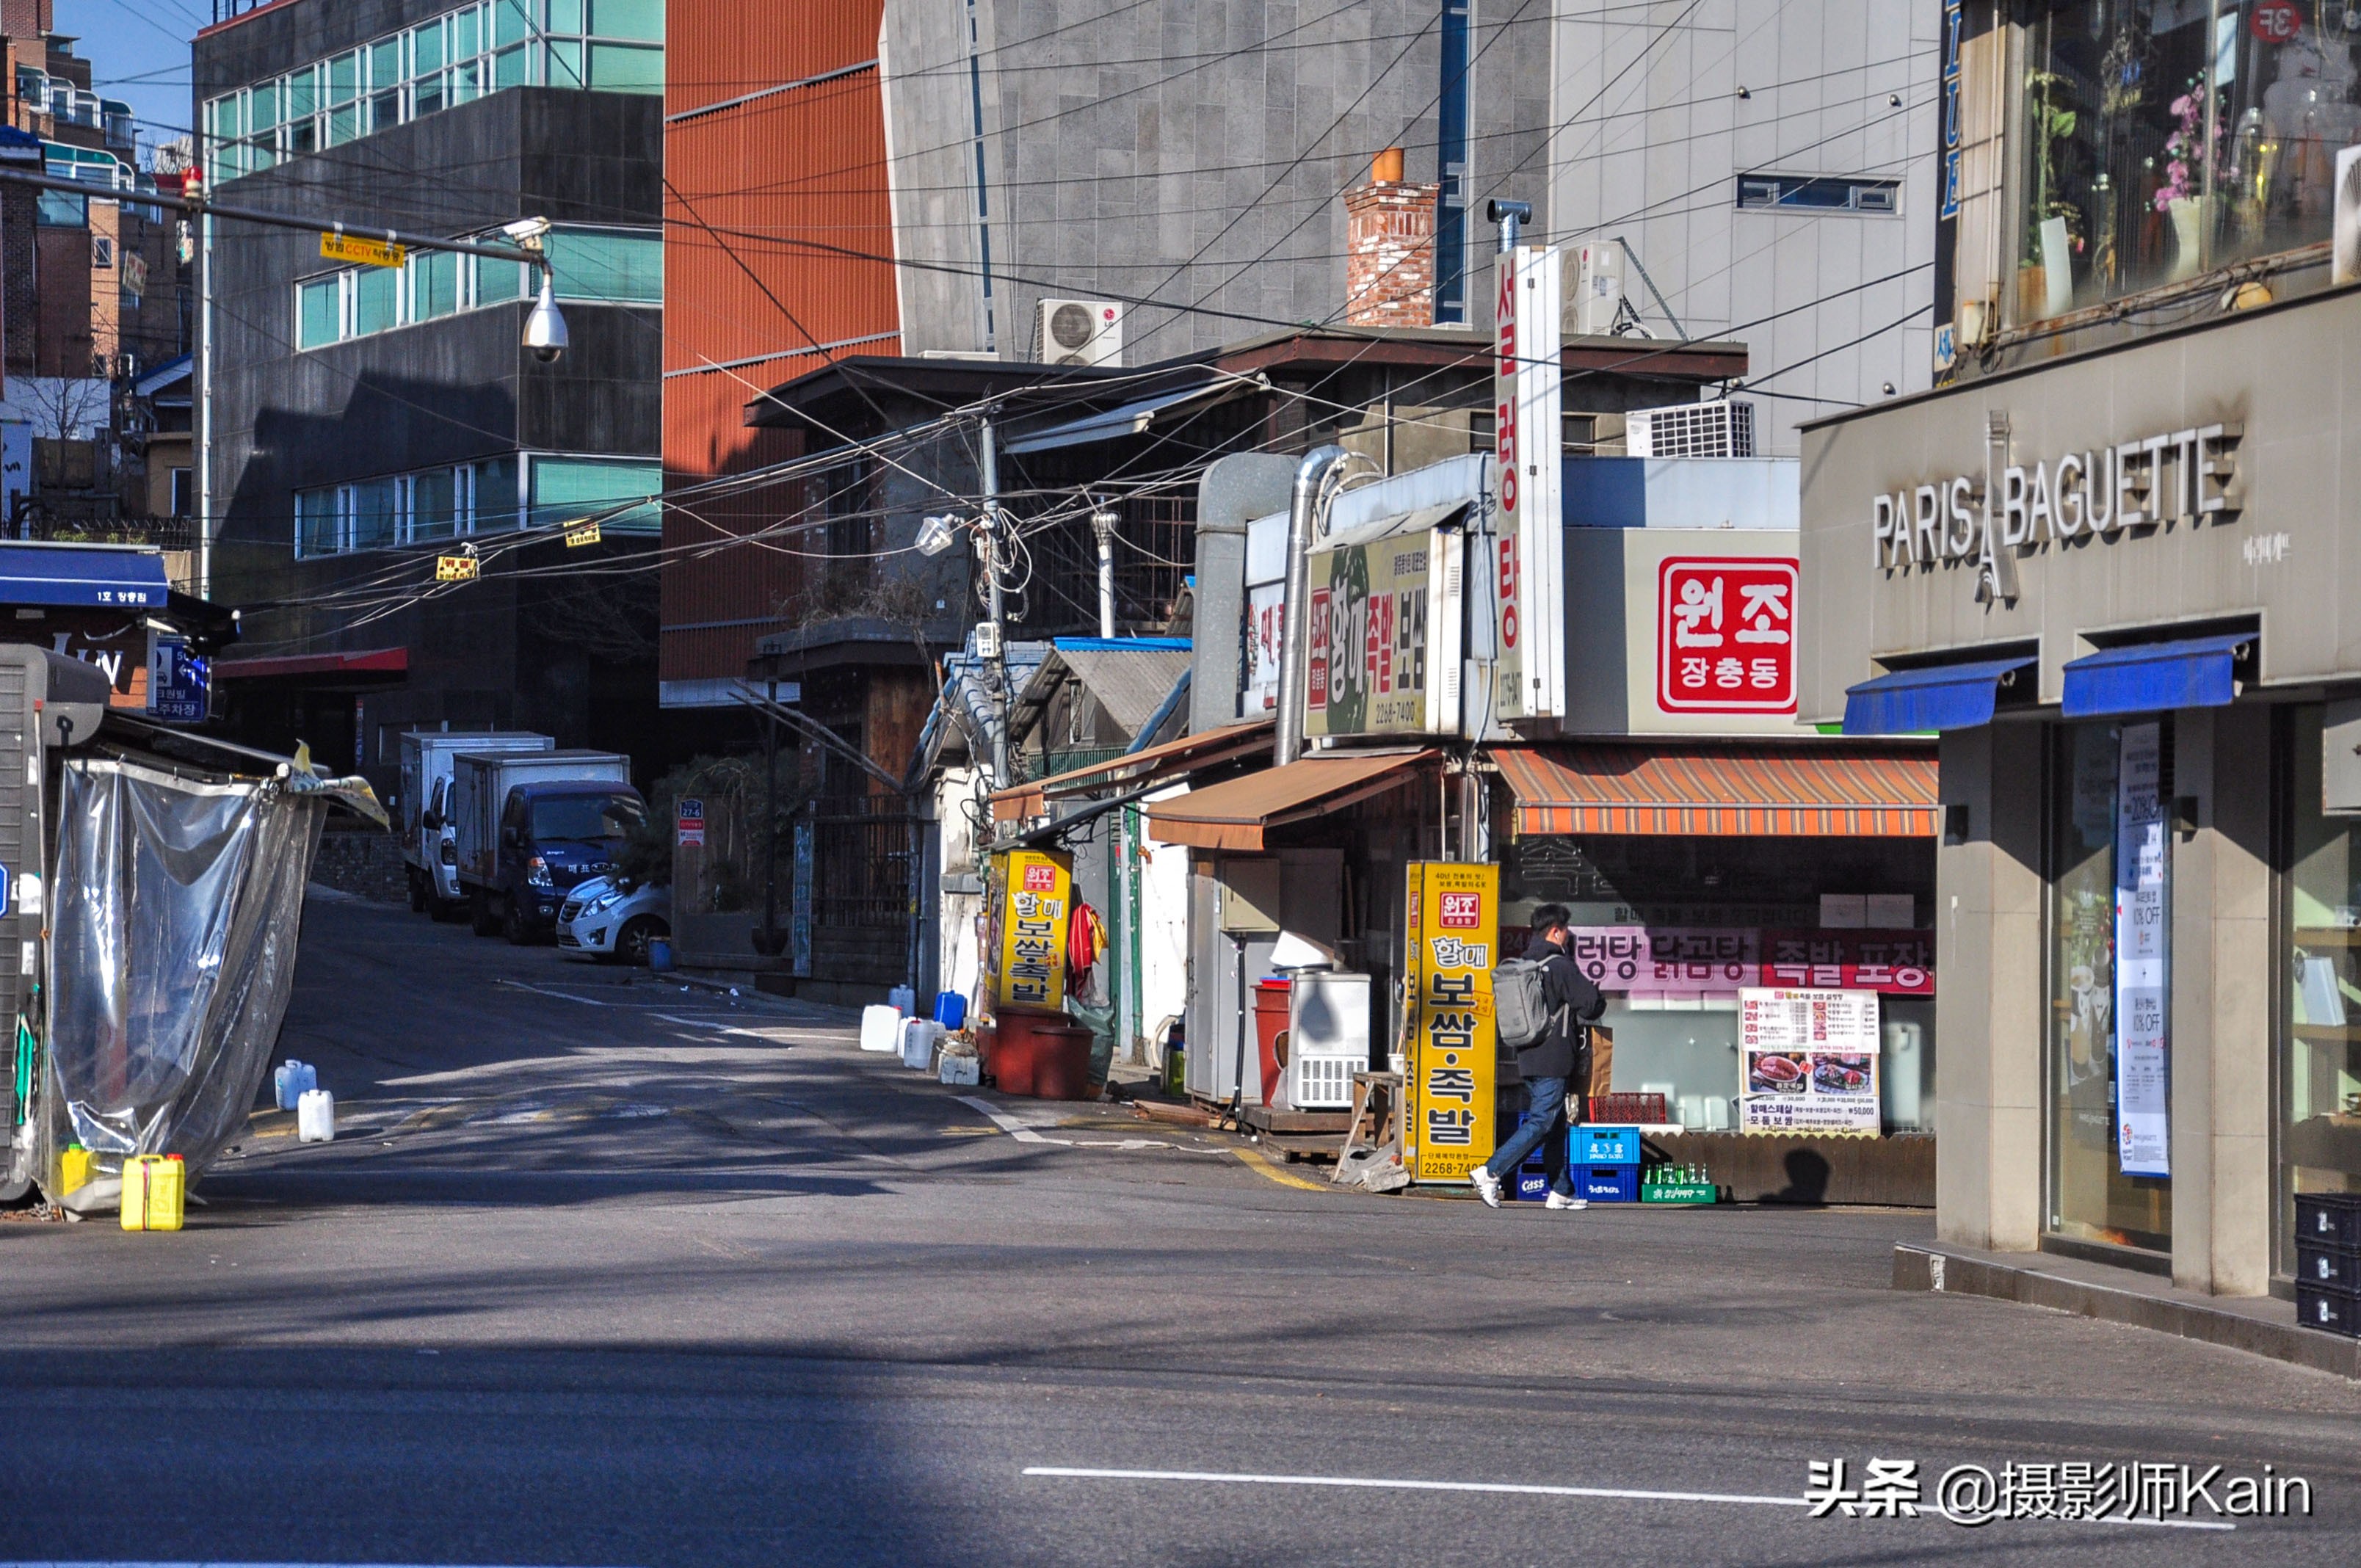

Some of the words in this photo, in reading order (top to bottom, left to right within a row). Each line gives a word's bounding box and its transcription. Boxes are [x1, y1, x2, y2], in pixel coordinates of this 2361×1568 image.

[345, 243, 371, 256] CCTV
[1496, 258, 1520, 649] 설렁탕
[1874, 476, 1975, 569] PARIS
[2003, 423, 2227, 547] BAGUETTE
[97, 592, 112, 602] 1호
[1672, 576, 1791, 650] 원조
[1680, 656, 1780, 689] 장충동
[1376, 702, 1415, 725] 2268-7400
[683, 808, 700, 816] 27-6
[1026, 867, 1053, 883] 원조
[1011, 891, 1063, 919] 할매
[1443, 896, 1476, 917] 원조
[2145, 906, 2161, 925] OFF
[1430, 936, 1488, 968] 할매
[1570, 934, 1643, 980] 렁탕
[1773, 940, 1845, 987] 족발
[1855, 940, 1929, 987] 포장
[2145, 1013, 2161, 1031] OFF
[1425, 1162, 1484, 1174] 2268-740
[1522, 1179, 1545, 1192] Cass
